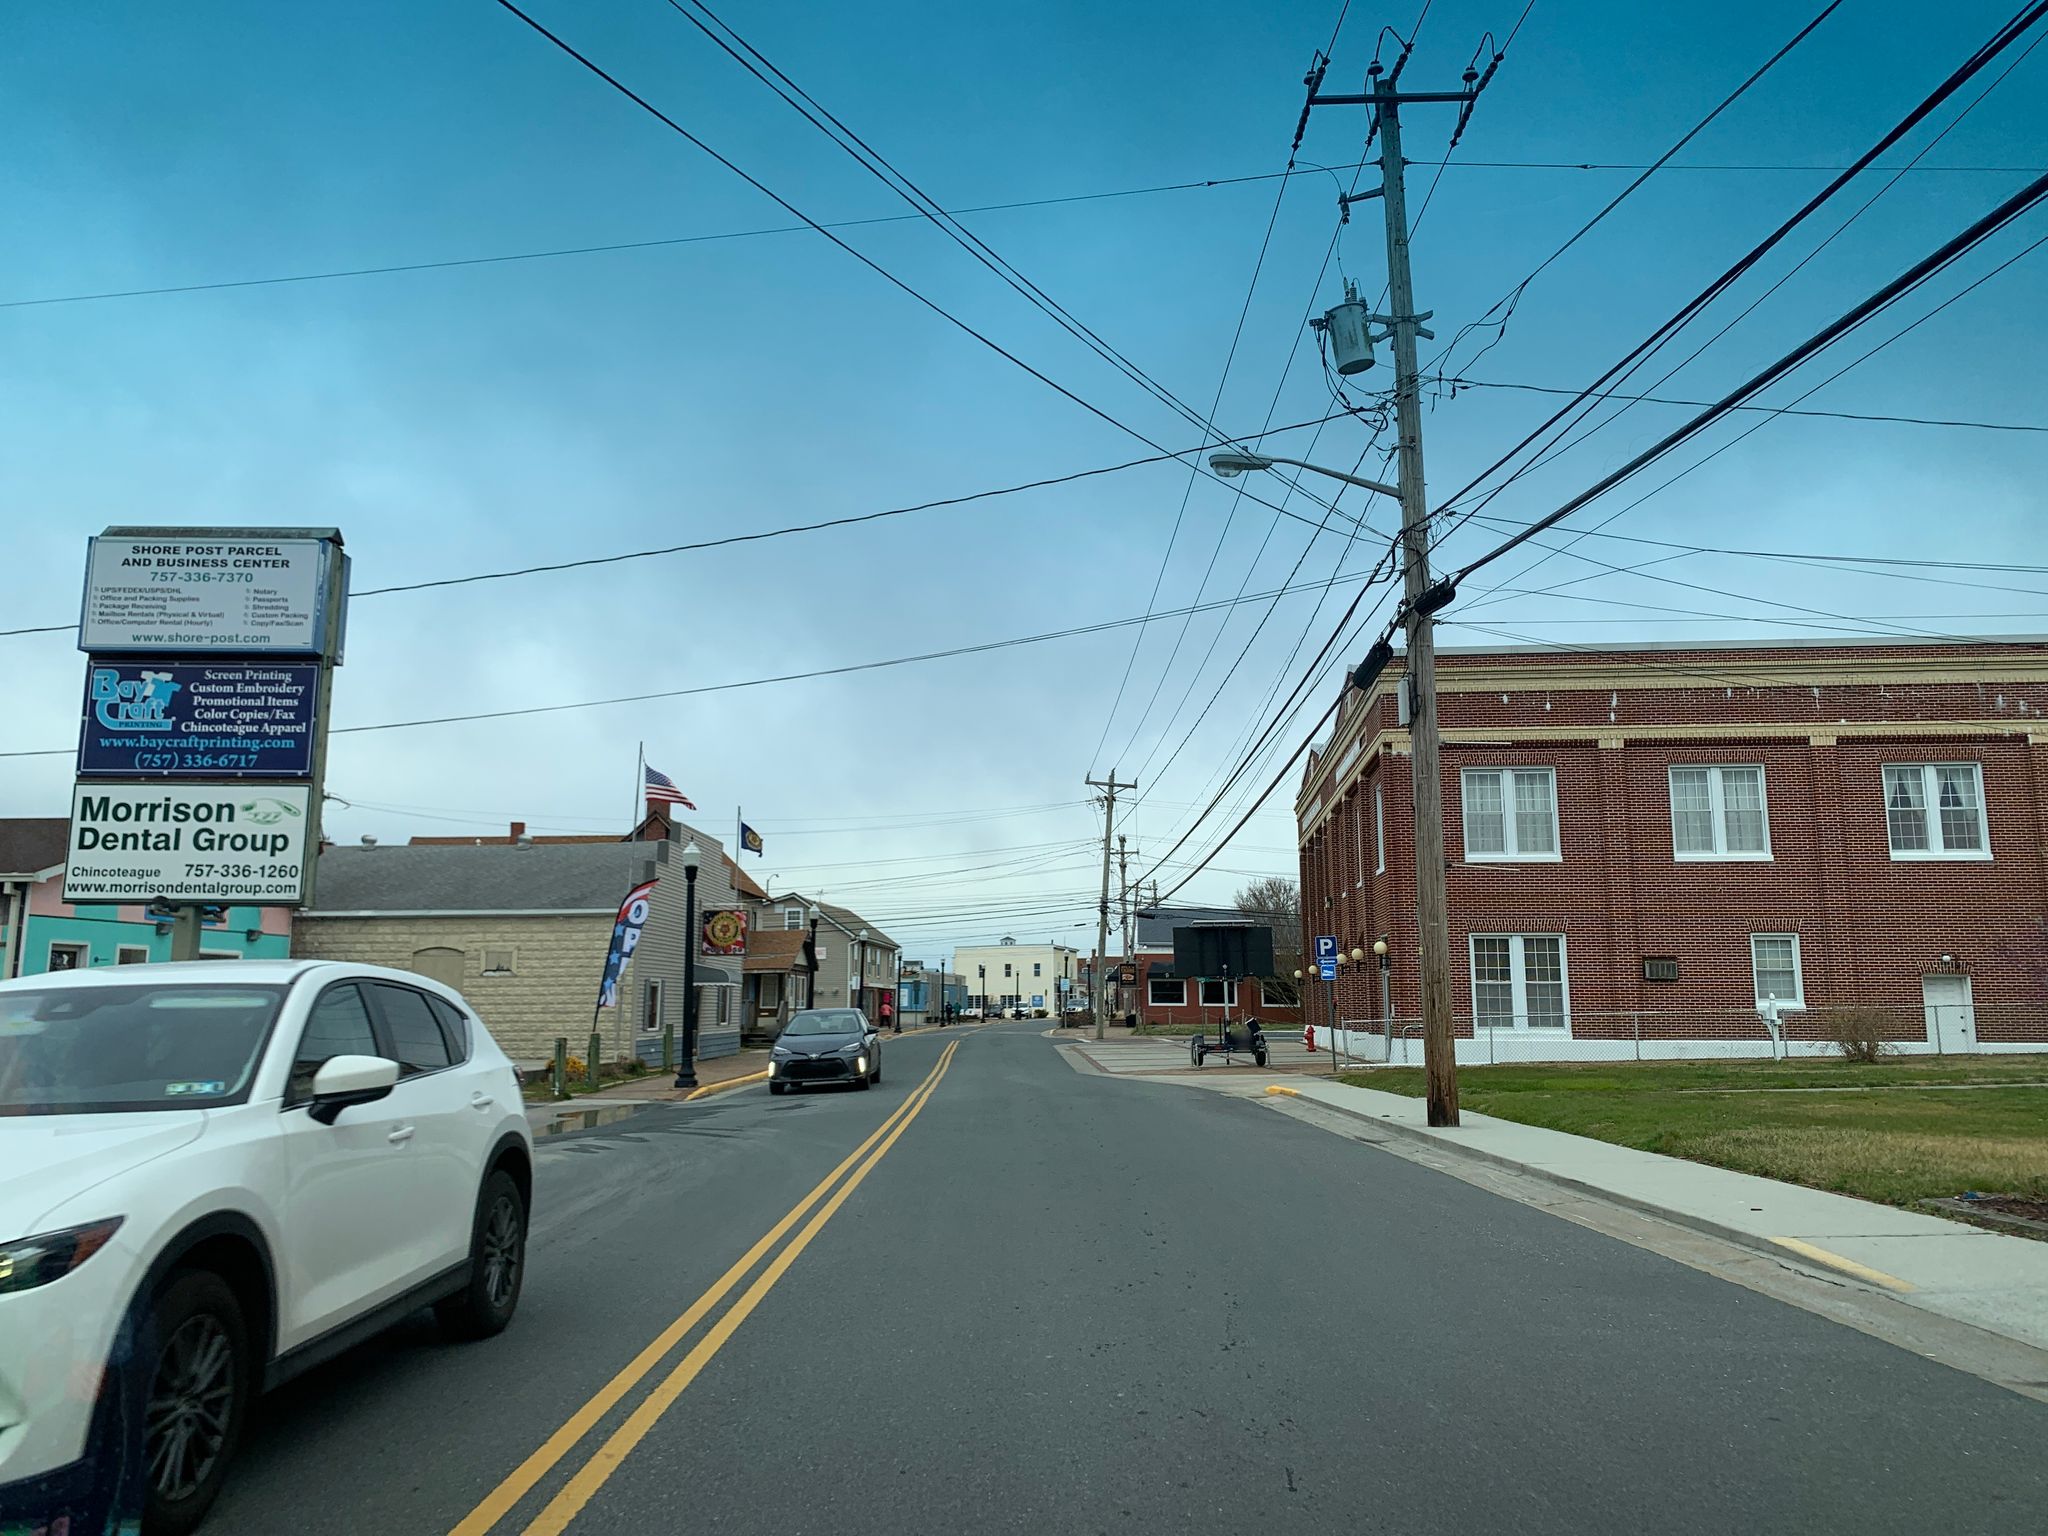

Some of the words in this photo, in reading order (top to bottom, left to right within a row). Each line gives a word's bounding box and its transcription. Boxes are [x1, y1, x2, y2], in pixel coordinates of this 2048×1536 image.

[132, 545, 181, 555] SHORE
[186, 546, 224, 556] POST
[228, 546, 282, 556] PARCEL
[121, 558, 152, 567] AND
[156, 558, 228, 568] BUSINESS
[233, 559, 290, 569] CENTER
[150, 572, 254, 583] 757-336-7370
[139, 595, 168, 603] Packing
[253, 588, 278, 596] Notary
[253, 596, 288, 604] Passports
[252, 604, 289, 612] Shredding
[281, 612, 308, 620] Packing
[132, 632, 271, 645] www.shore-post.com
[204, 669, 242, 680] Screen
[245, 670, 292, 683] Printing
[92, 668, 149, 702] Bay
[189, 682, 234, 693] Custom
[236, 682, 305, 696] Embroidery
[192, 695, 265, 706] Promotional
[267, 696, 299, 706] Items
[95, 697, 168, 728] Craft
[194, 708, 228, 719] Color
[229, 708, 296, 722] Copies/Fax
[181, 721, 259, 735] Chincoteague
[260, 722, 306, 736] Apparel
[99, 735, 295, 752] www.baycraftprinting.com
[135, 751, 179, 769] (757)
[182, 753, 258, 767] 336-6717
[80, 796, 235, 823] Morrison
[78, 827, 181, 851] Dental
[192, 827, 289, 857] Group
[71, 866, 161, 879] Chincoteague
[185, 864, 299, 878] 757-336-1260
[67, 881, 296, 896] www.morrisondentalgroup.com
[1320, 939, 1333, 955] P
